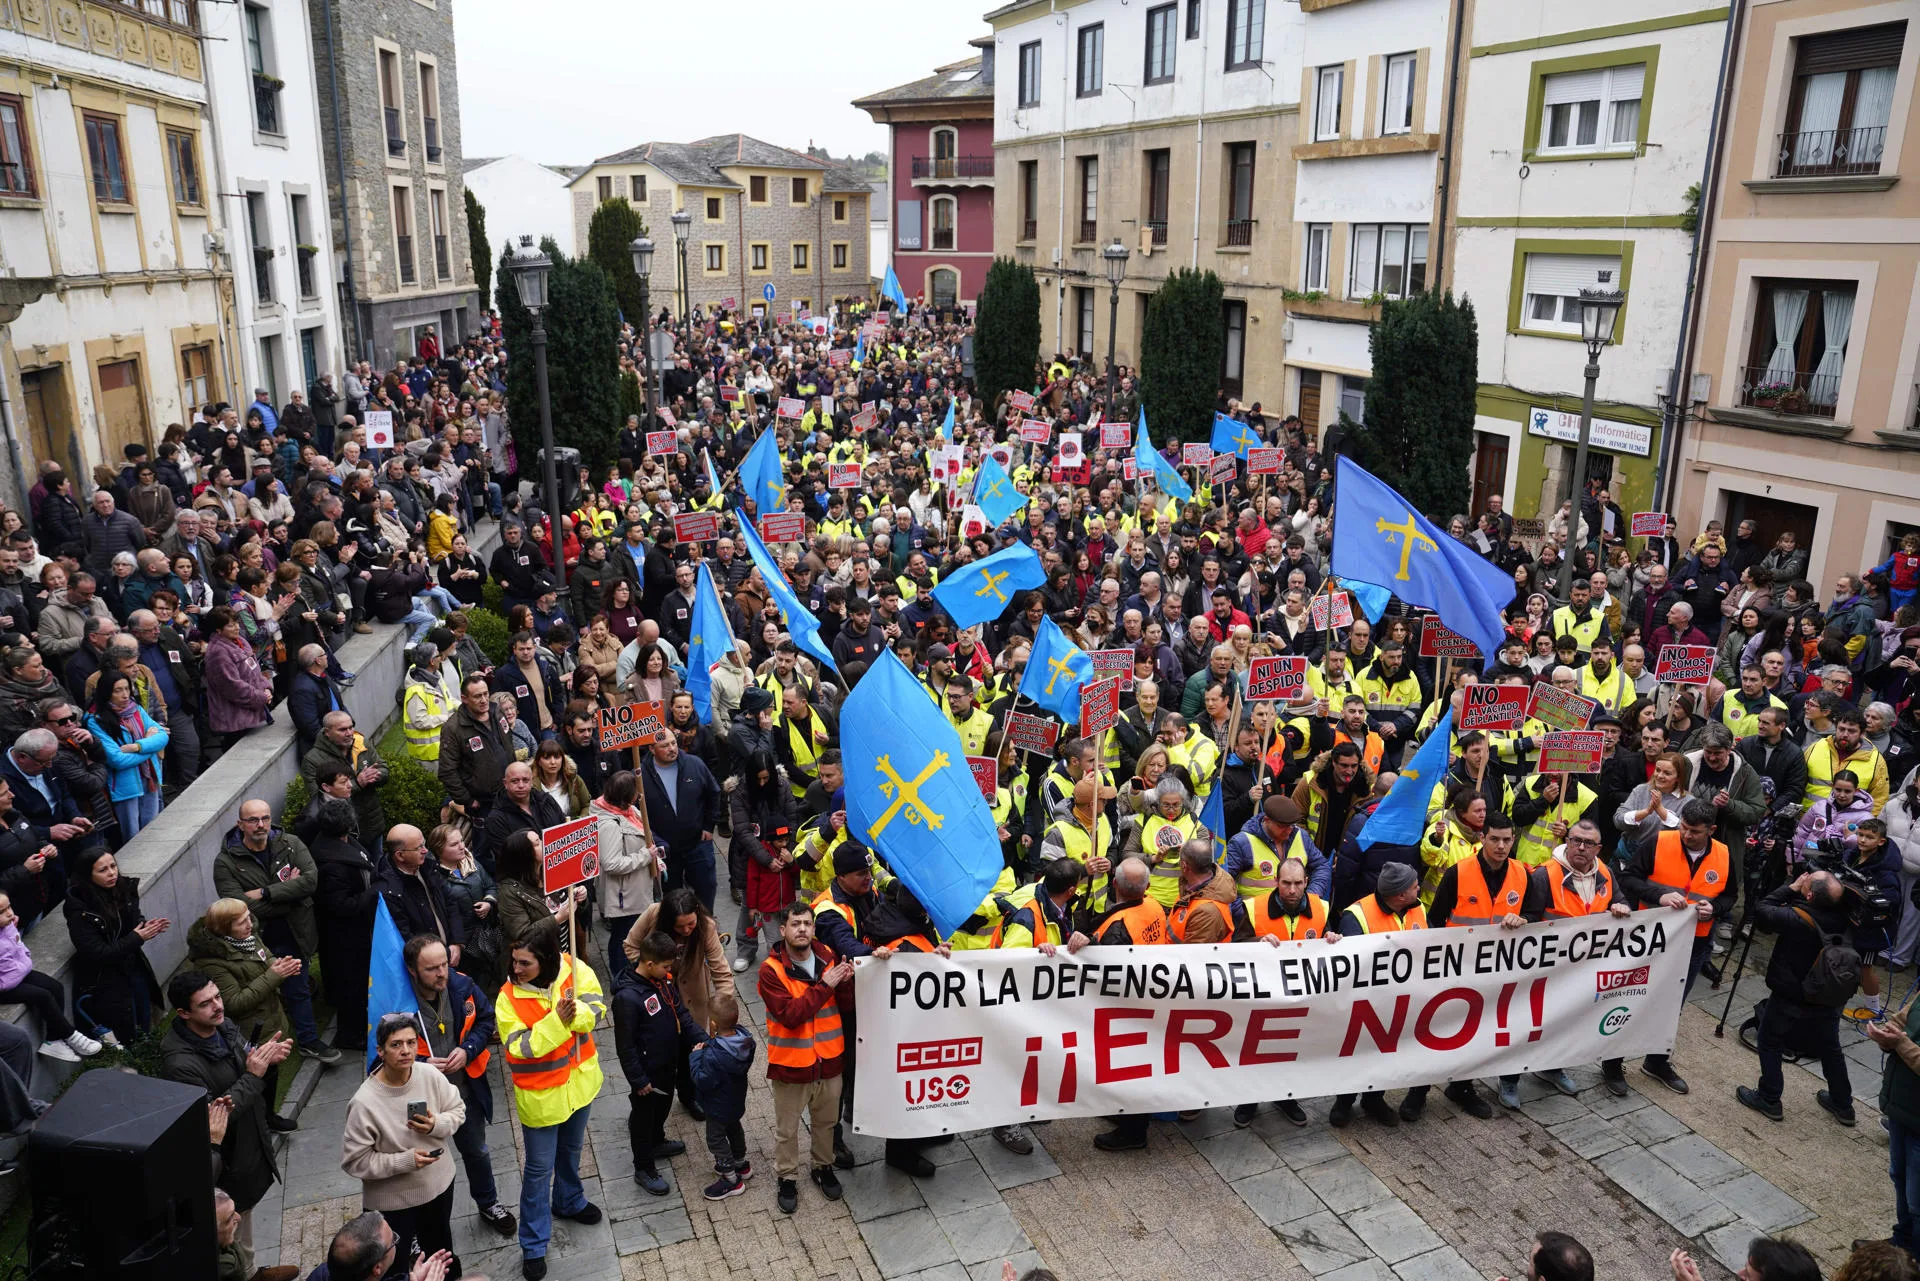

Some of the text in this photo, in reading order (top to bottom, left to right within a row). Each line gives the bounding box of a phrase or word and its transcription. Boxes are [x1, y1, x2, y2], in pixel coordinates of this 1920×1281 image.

[1594, 423, 1648, 443] Informática
[833, 465, 847, 474] NO
[1766, 485, 1772, 494] 7
[1425, 621, 1440, 630] SIN
[1106, 653, 1134, 661] ARREGLA
[1437, 647, 1471, 656] SOCIAL
[1662, 647, 1688, 662] ¡NO
[1105, 660, 1131, 669] GESTIÓN
[1257, 658, 1292, 680] NI UN
[1671, 657, 1706, 669] SOMOS
[1249, 672, 1304, 697] DESPIDO
[1083, 693, 1093, 704] SIN
[1470, 686, 1499, 705] NO
[1543, 685, 1555, 695] ERE
[1555, 691, 1565, 699] NO
[1566, 696, 1593, 713] ARREGLA
[1544, 694, 1562, 706] MALA
[1090, 700, 1098, 710] NO
[1468, 701, 1519, 717] AL VACIADO
[601, 705, 633, 727] NO
[1088, 703, 1113, 725] LICENCIA
[1464, 717, 1476, 727] DE
[1477, 710, 1522, 724] PLANTILLA
[604, 715, 657, 740] AL VACIADO
[1029, 726, 1044, 734] HAY
[1091, 717, 1110, 734] SOCIAL
[601, 738, 614, 749] DE
[615, 722, 664, 745] PLANTILLA
[1574, 734, 1604, 743] ARREGLA
[1016, 741, 1041, 751] SOCIAL
[544, 820, 598, 856] AUTOMATIZACIÓN
[547, 836, 597, 870] A LA DIRECCIÓN
[890, 921, 1666, 1010] POR LA DEFENSA DEL EMPLEO EN ENCE-CEASA
[1599, 971, 1635, 990] UGT
[1606, 1014, 1632, 1027] CSIF
[1020, 976, 1548, 1106] ¡¡ERE NO!!
[900, 1042, 980, 1067] CCOO
[905, 1074, 971, 1105] USO
[905, 1099, 970, 1112] UNIÓN SINDICAL OBRERA
